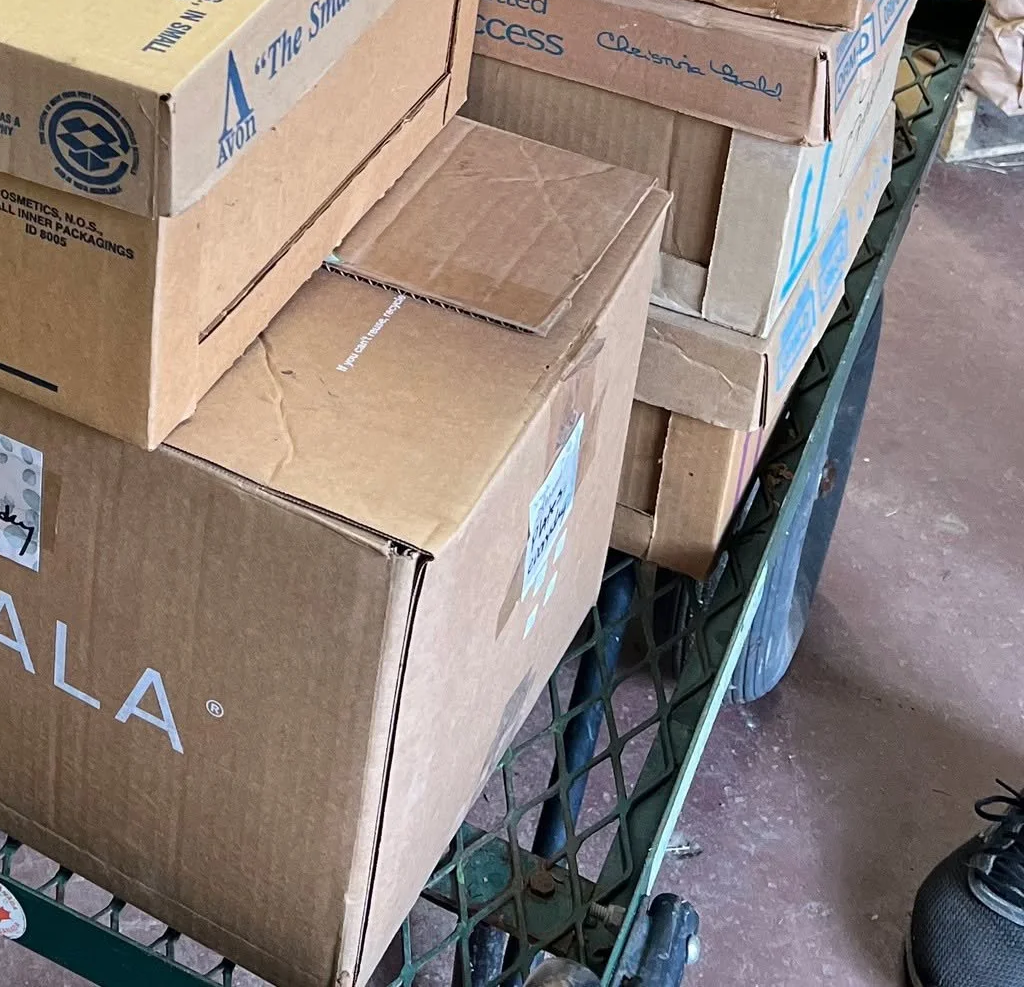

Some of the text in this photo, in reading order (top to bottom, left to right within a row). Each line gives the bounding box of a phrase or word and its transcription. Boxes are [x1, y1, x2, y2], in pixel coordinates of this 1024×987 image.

[179, 9, 207, 23] IN
[142, 22, 193, 54] SMALL
[0, 112, 12, 123] AS
[14, 116, 21, 128] A
[18, 208, 53, 229] INNER
[55, 222, 135, 260] PACKAGINGS
[25, 223, 68, 248] ID 8005
[344, 352, 360, 368] you
[354, 335, 373, 353] can't
